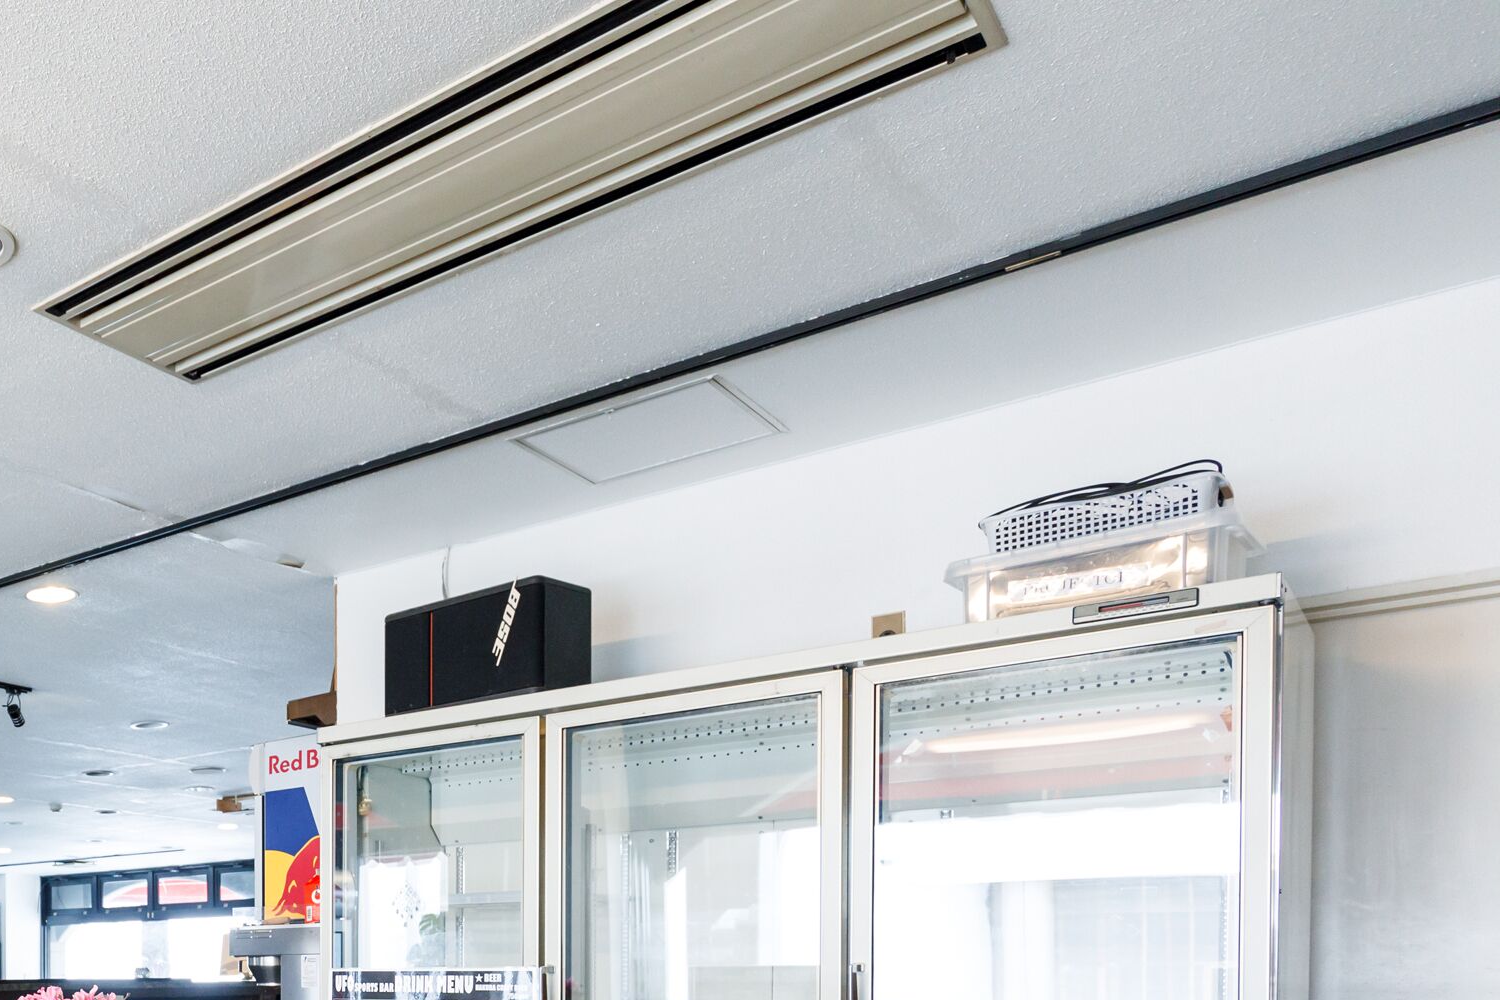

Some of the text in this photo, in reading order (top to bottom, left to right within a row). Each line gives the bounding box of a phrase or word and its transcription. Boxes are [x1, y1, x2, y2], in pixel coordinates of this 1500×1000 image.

[492, 580, 520, 666] BOSE
[269, 749, 319, 774] Red B
[335, 975, 473, 993] UFO SPORTS BAR DRINK MENU
[484, 974, 501, 982] BEER
